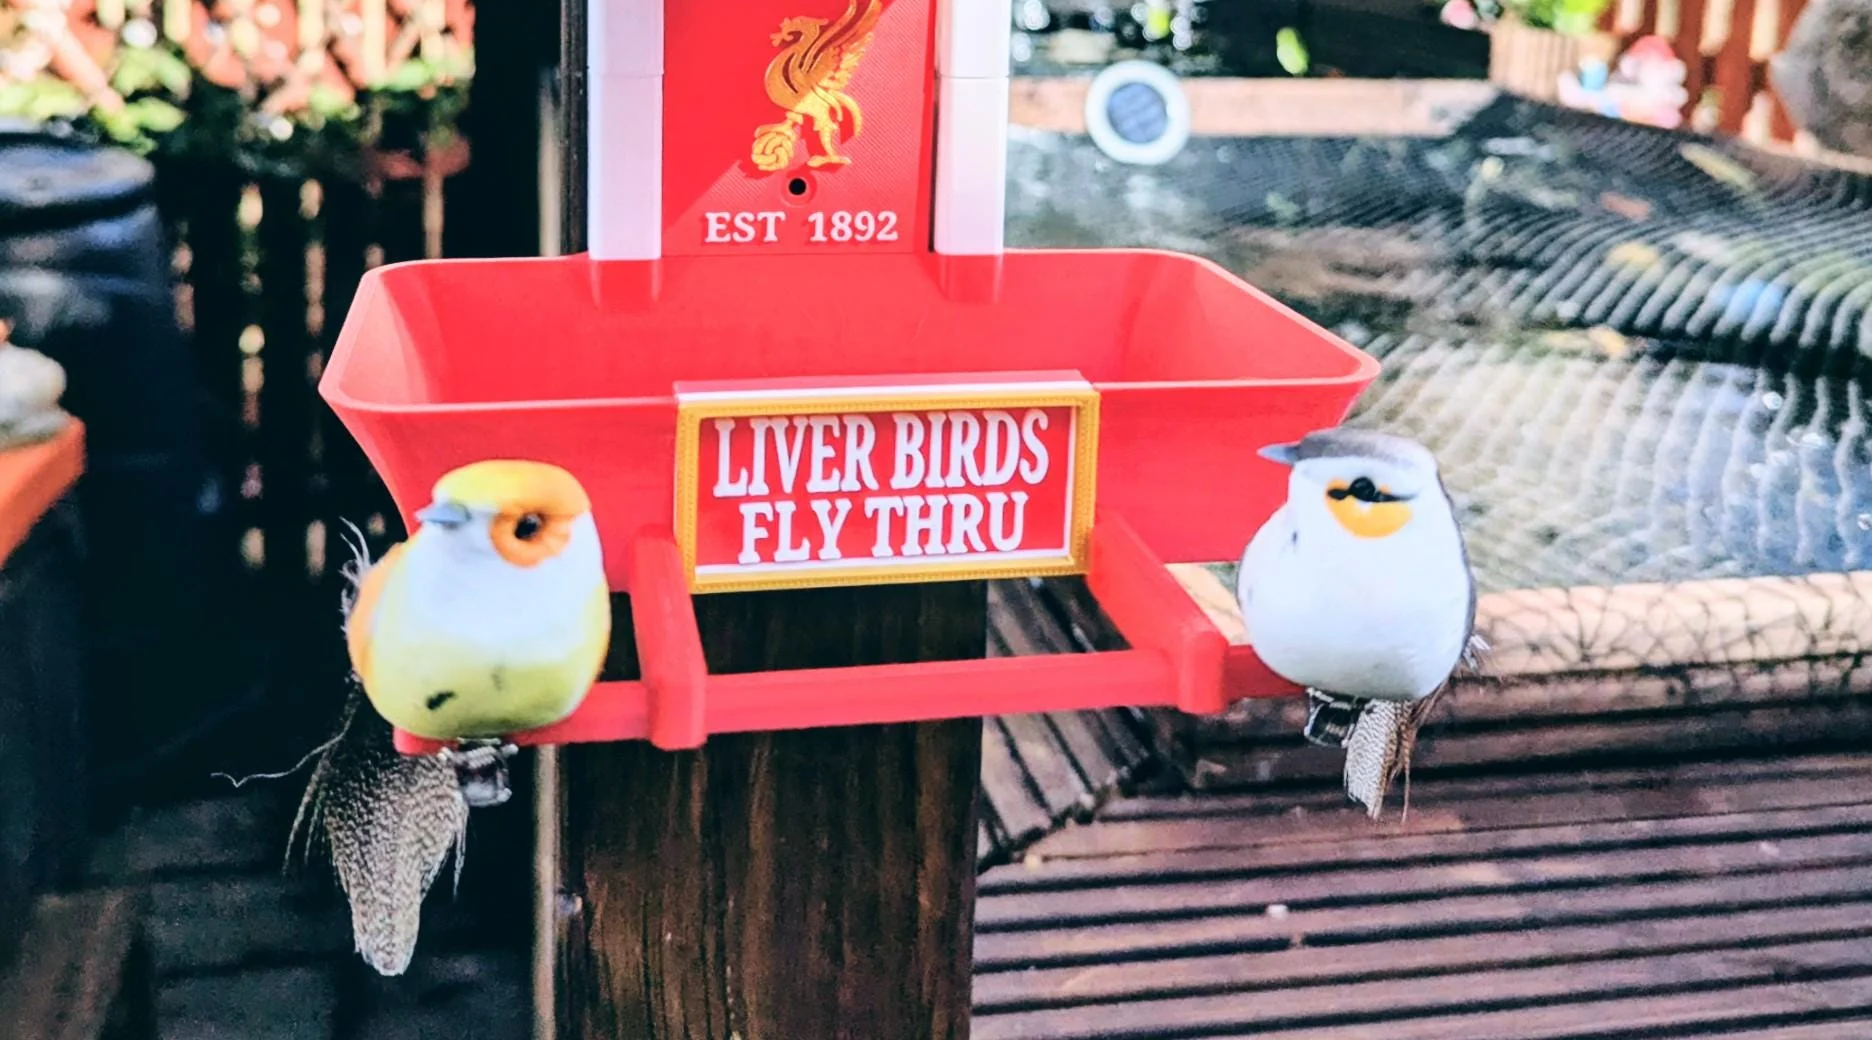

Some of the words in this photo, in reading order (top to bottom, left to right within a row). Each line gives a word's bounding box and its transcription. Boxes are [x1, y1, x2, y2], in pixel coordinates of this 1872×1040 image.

[704, 211, 786, 243] EST
[807, 210, 899, 242] 1892
[713, 414, 879, 498] LIVER
[890, 408, 1050, 490] BIRDS
[738, 498, 852, 565] FLY
[864, 491, 1029, 558] THRU
